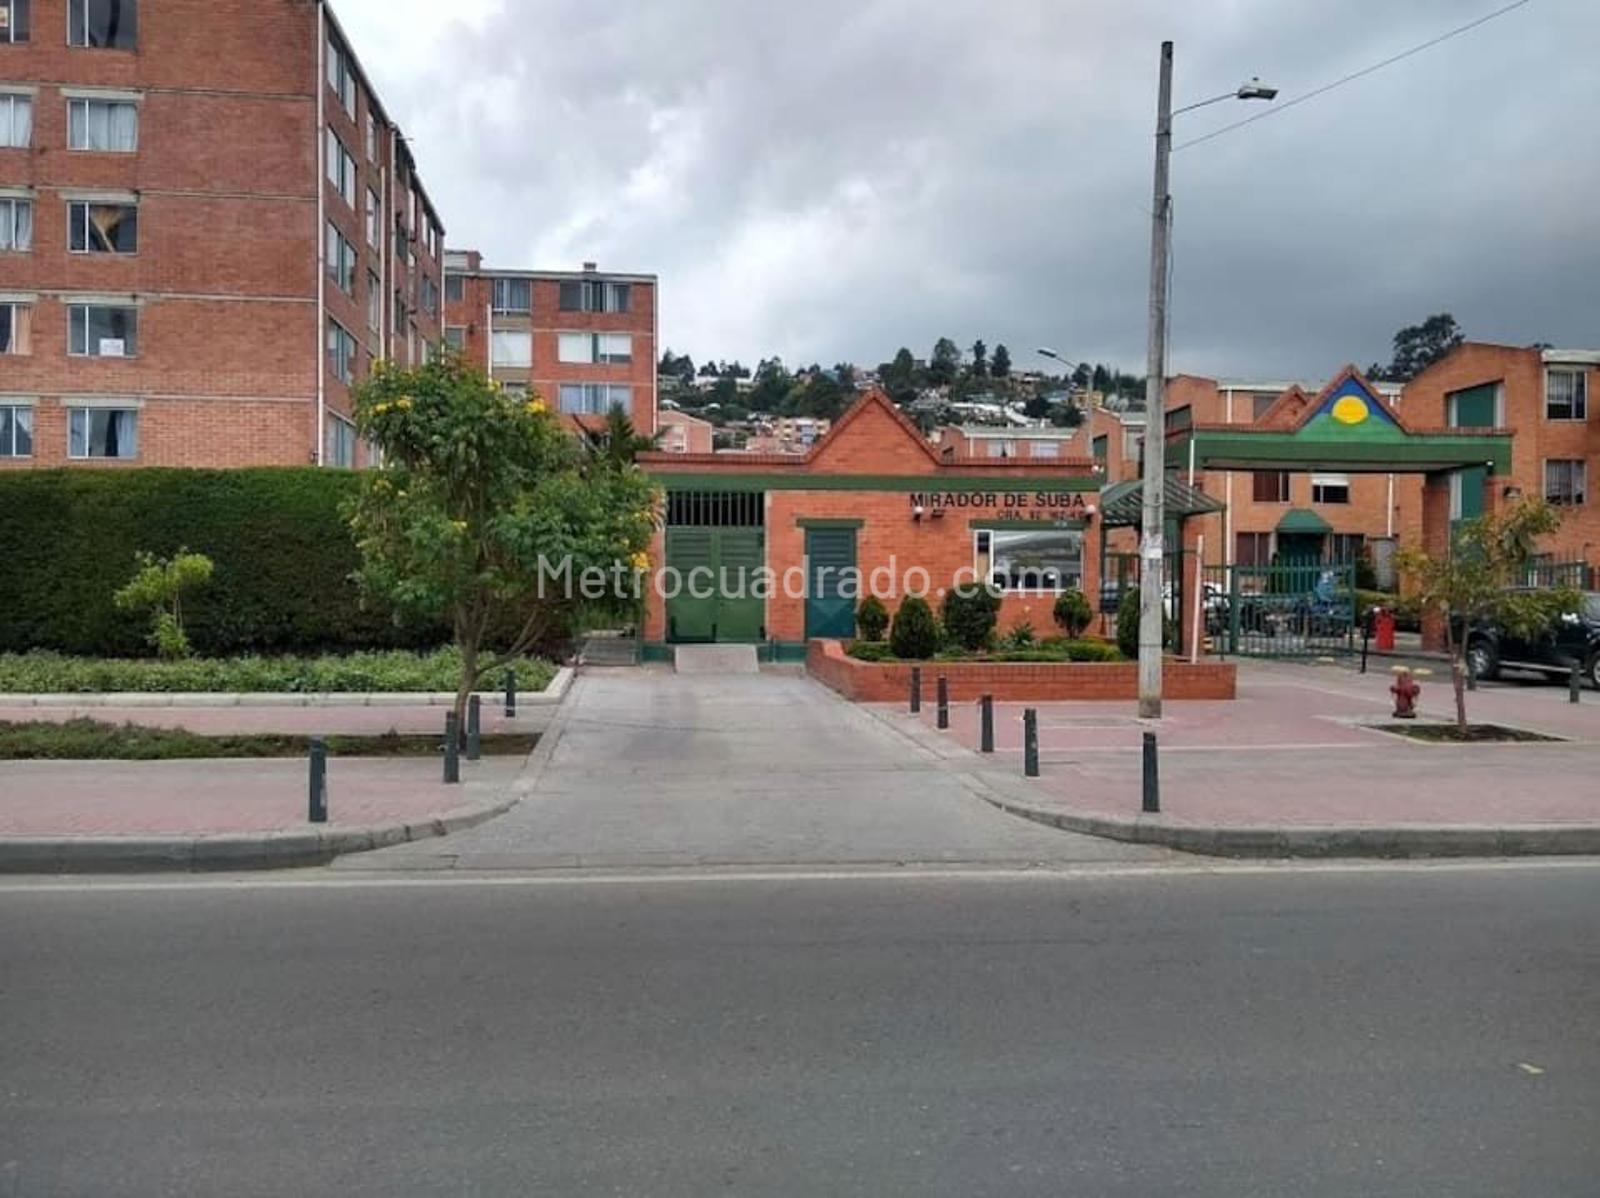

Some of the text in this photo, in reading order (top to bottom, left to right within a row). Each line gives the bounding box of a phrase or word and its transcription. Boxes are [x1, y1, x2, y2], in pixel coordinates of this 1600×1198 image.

[909, 493, 1085, 508] MIRADOR DE SUBA
